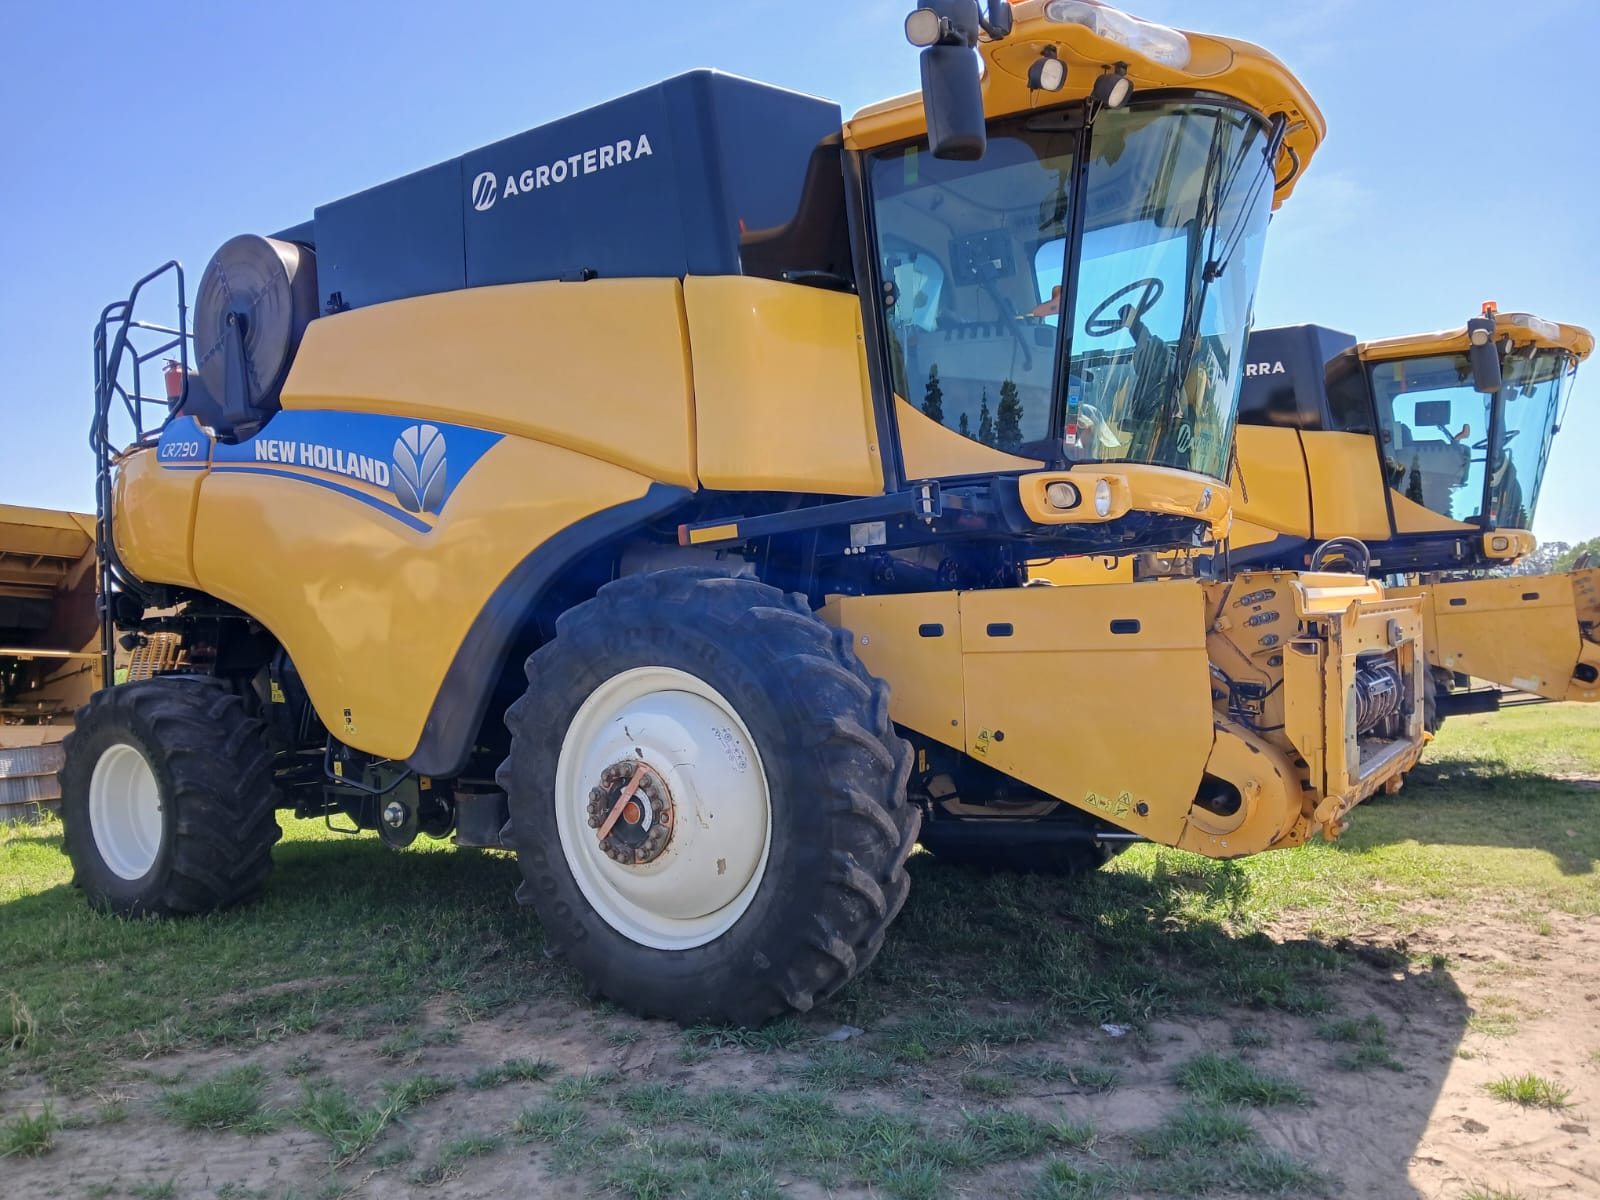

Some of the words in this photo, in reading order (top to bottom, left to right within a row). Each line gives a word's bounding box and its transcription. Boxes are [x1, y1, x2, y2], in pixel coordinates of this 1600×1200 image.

[502, 133, 653, 199] AGROTERRA
[1242, 361, 1286, 377] RRA
[255, 439, 297, 463] NEW
[299, 442, 390, 487] HOLLAND
